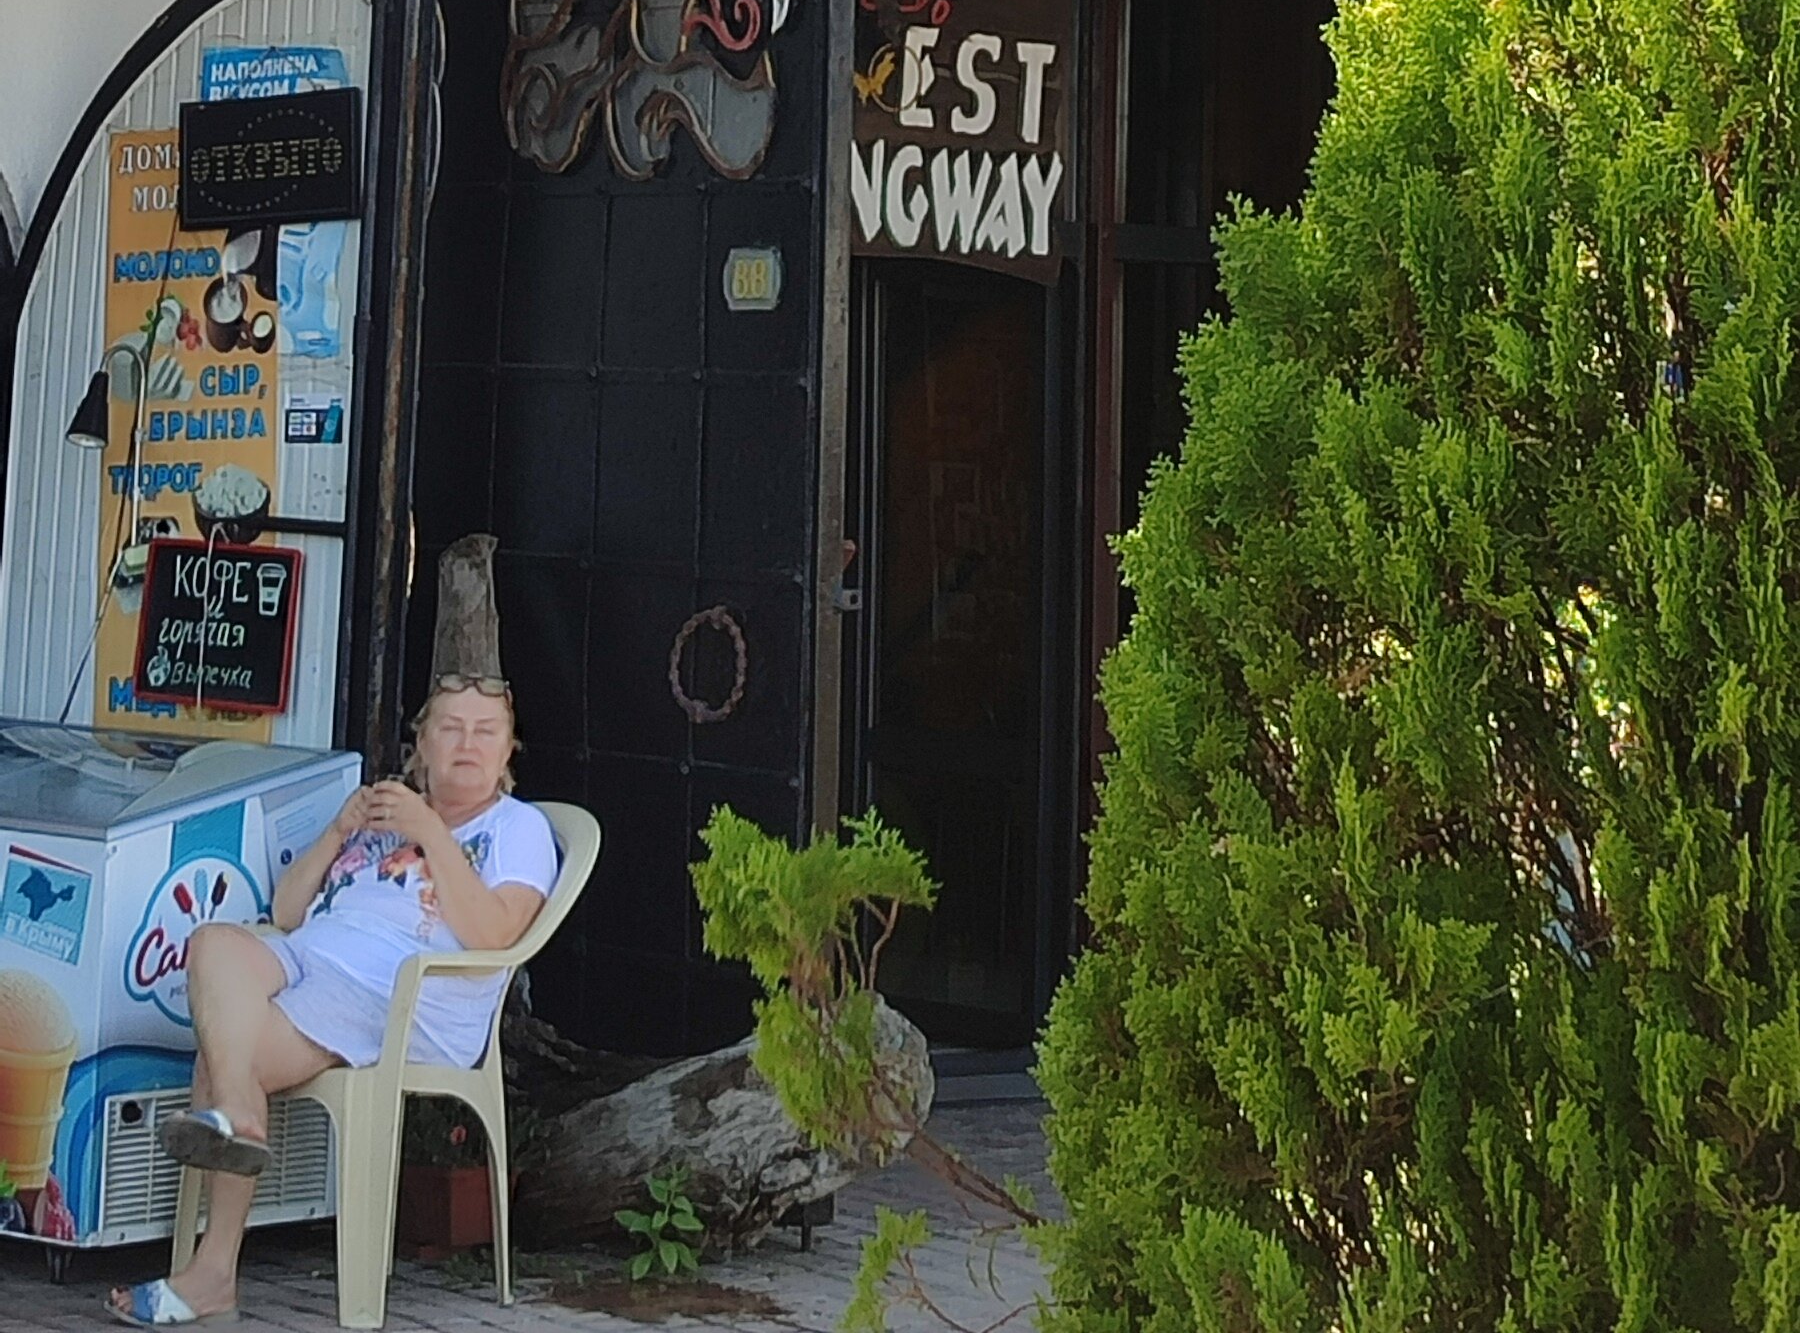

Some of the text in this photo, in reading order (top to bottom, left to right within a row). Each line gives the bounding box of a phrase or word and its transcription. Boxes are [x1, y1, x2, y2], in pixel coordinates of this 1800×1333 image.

[119, 143, 179, 174] ДОМ
[190, 137, 342, 183] ОТКРЫТО
[114, 246, 221, 283] МОЛОКО
[149, 407, 266, 442] БРЫНЗА
[173, 554, 252, 606] КОФЕ
